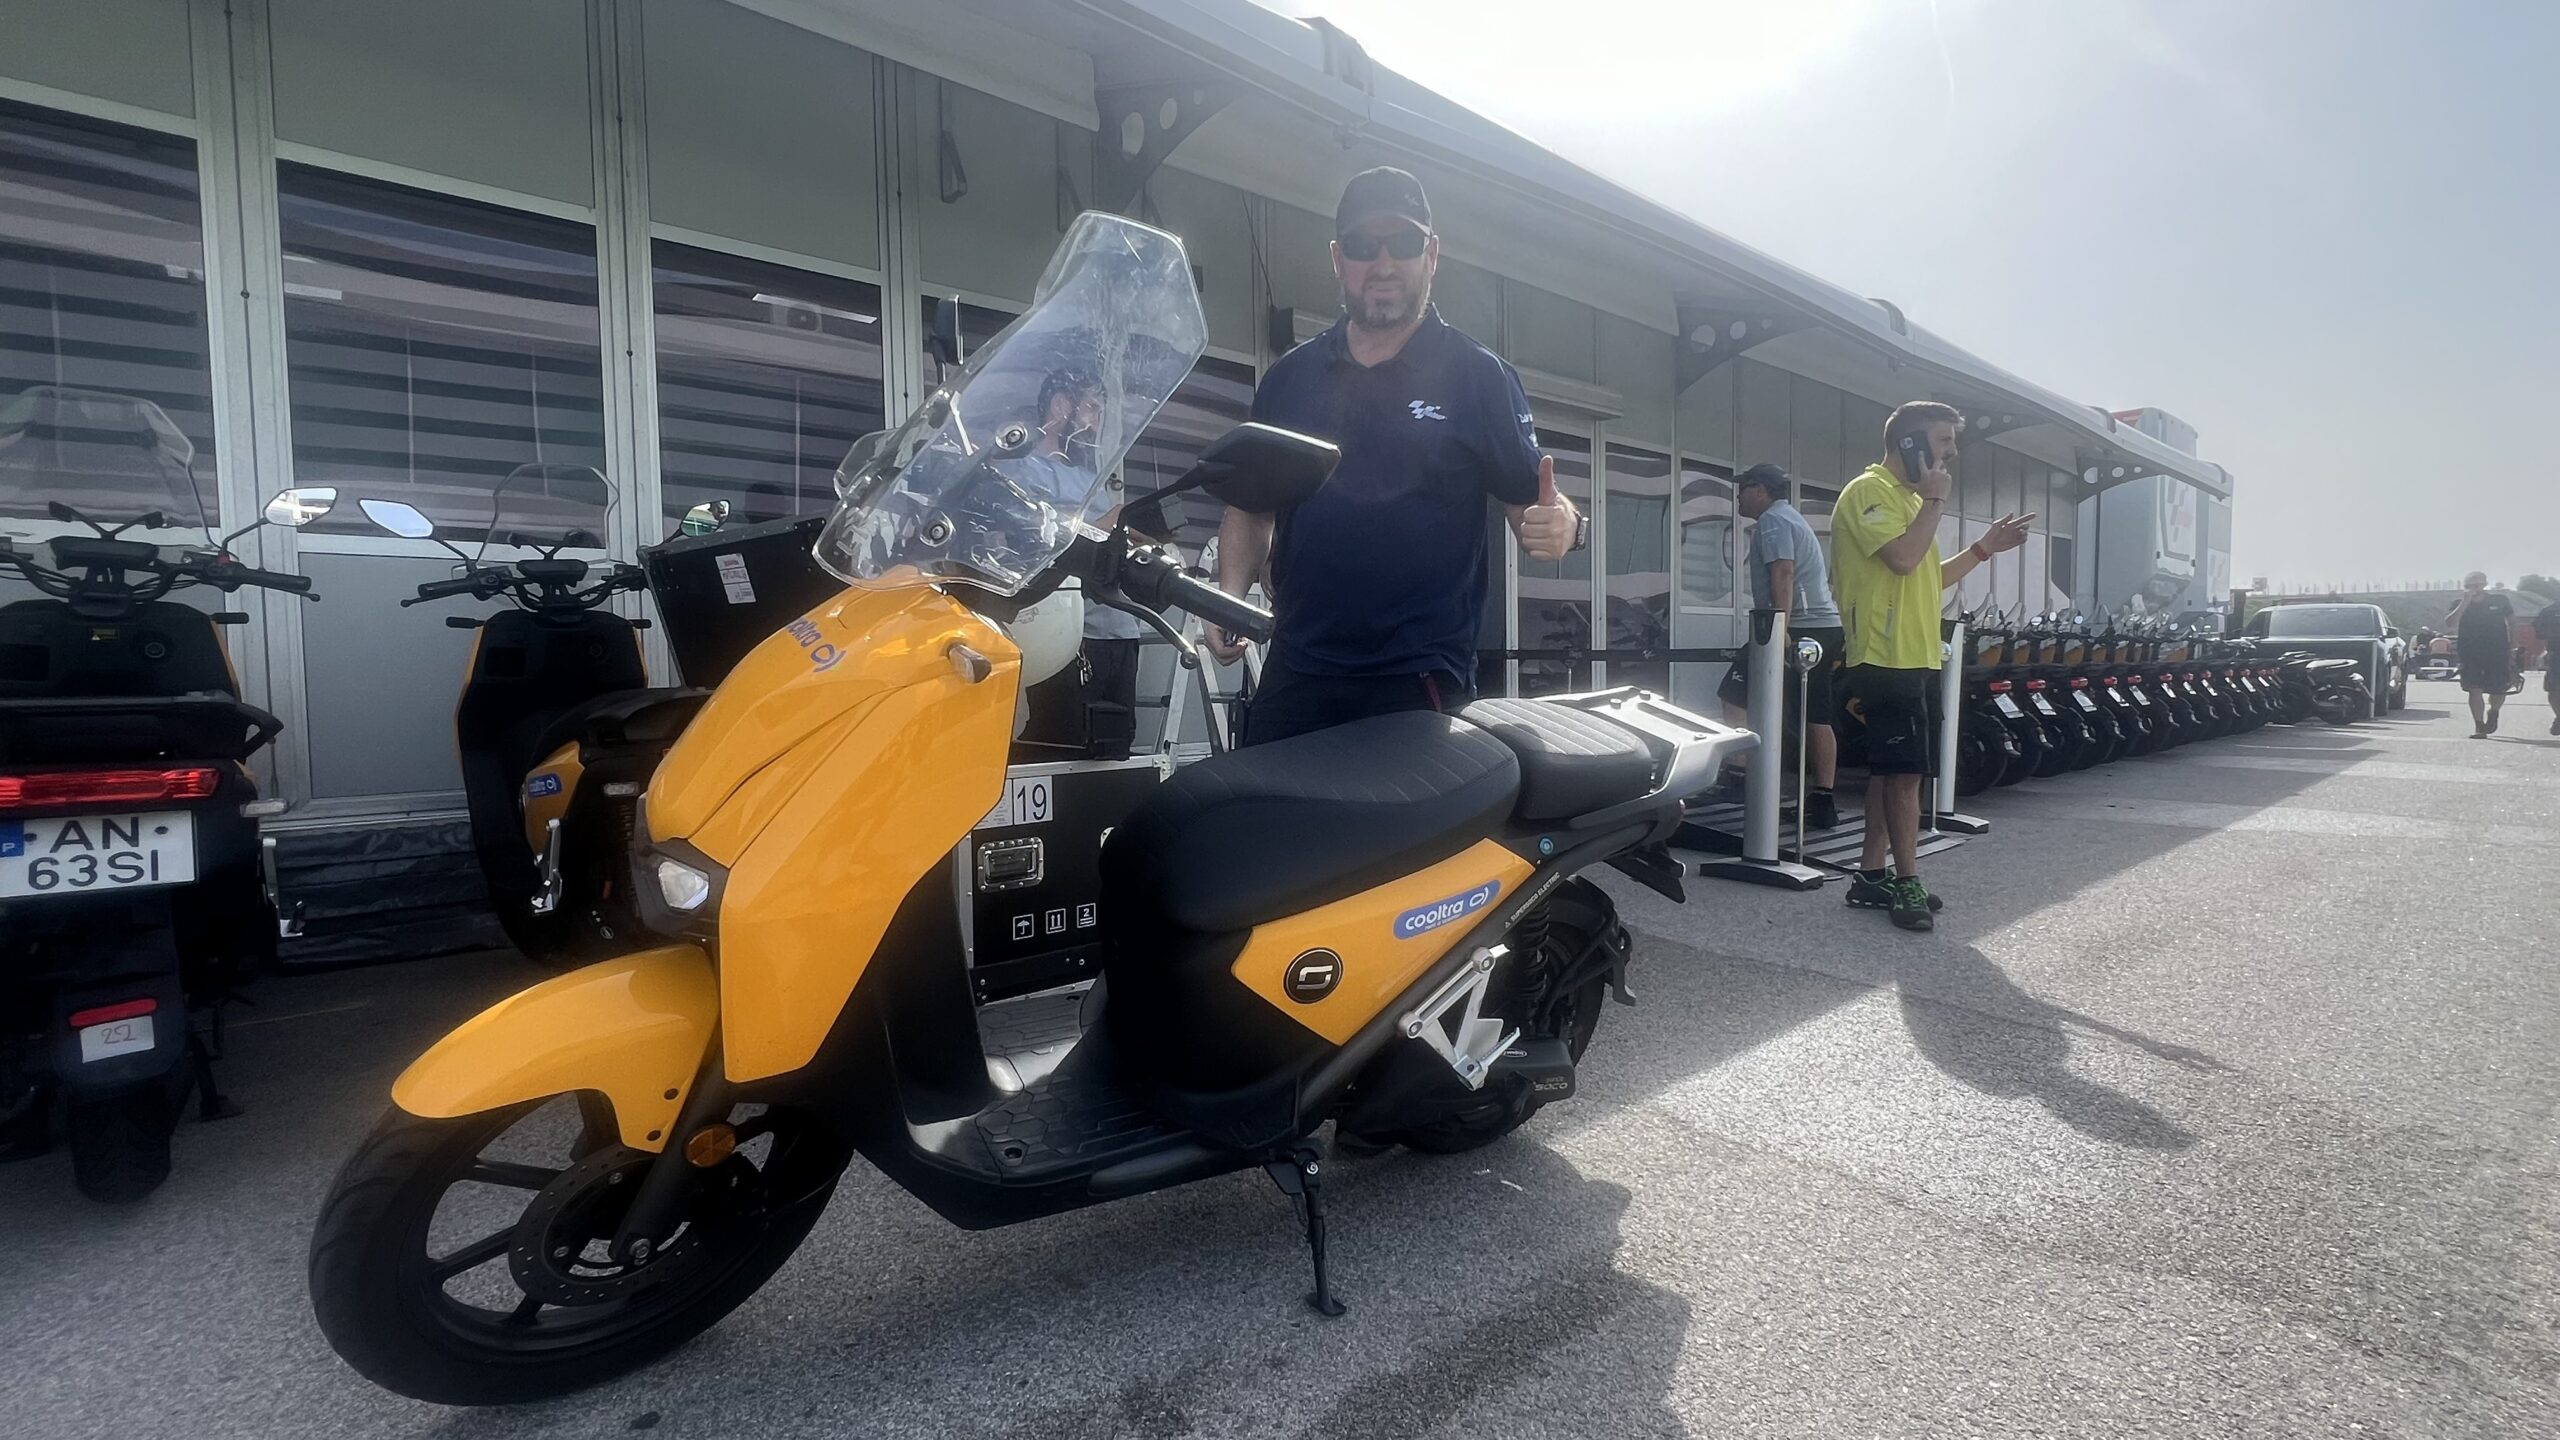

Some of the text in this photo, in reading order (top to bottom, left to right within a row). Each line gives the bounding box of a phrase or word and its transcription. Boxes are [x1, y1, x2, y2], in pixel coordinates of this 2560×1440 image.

[1017, 783, 1047, 822] 19
[2, 843, 15, 852] P
[50, 816, 140, 853] AN
[28, 849, 159, 890] 63SI
[1083, 908, 1090, 917] 2
[1405, 900, 1464, 930] cooltra
